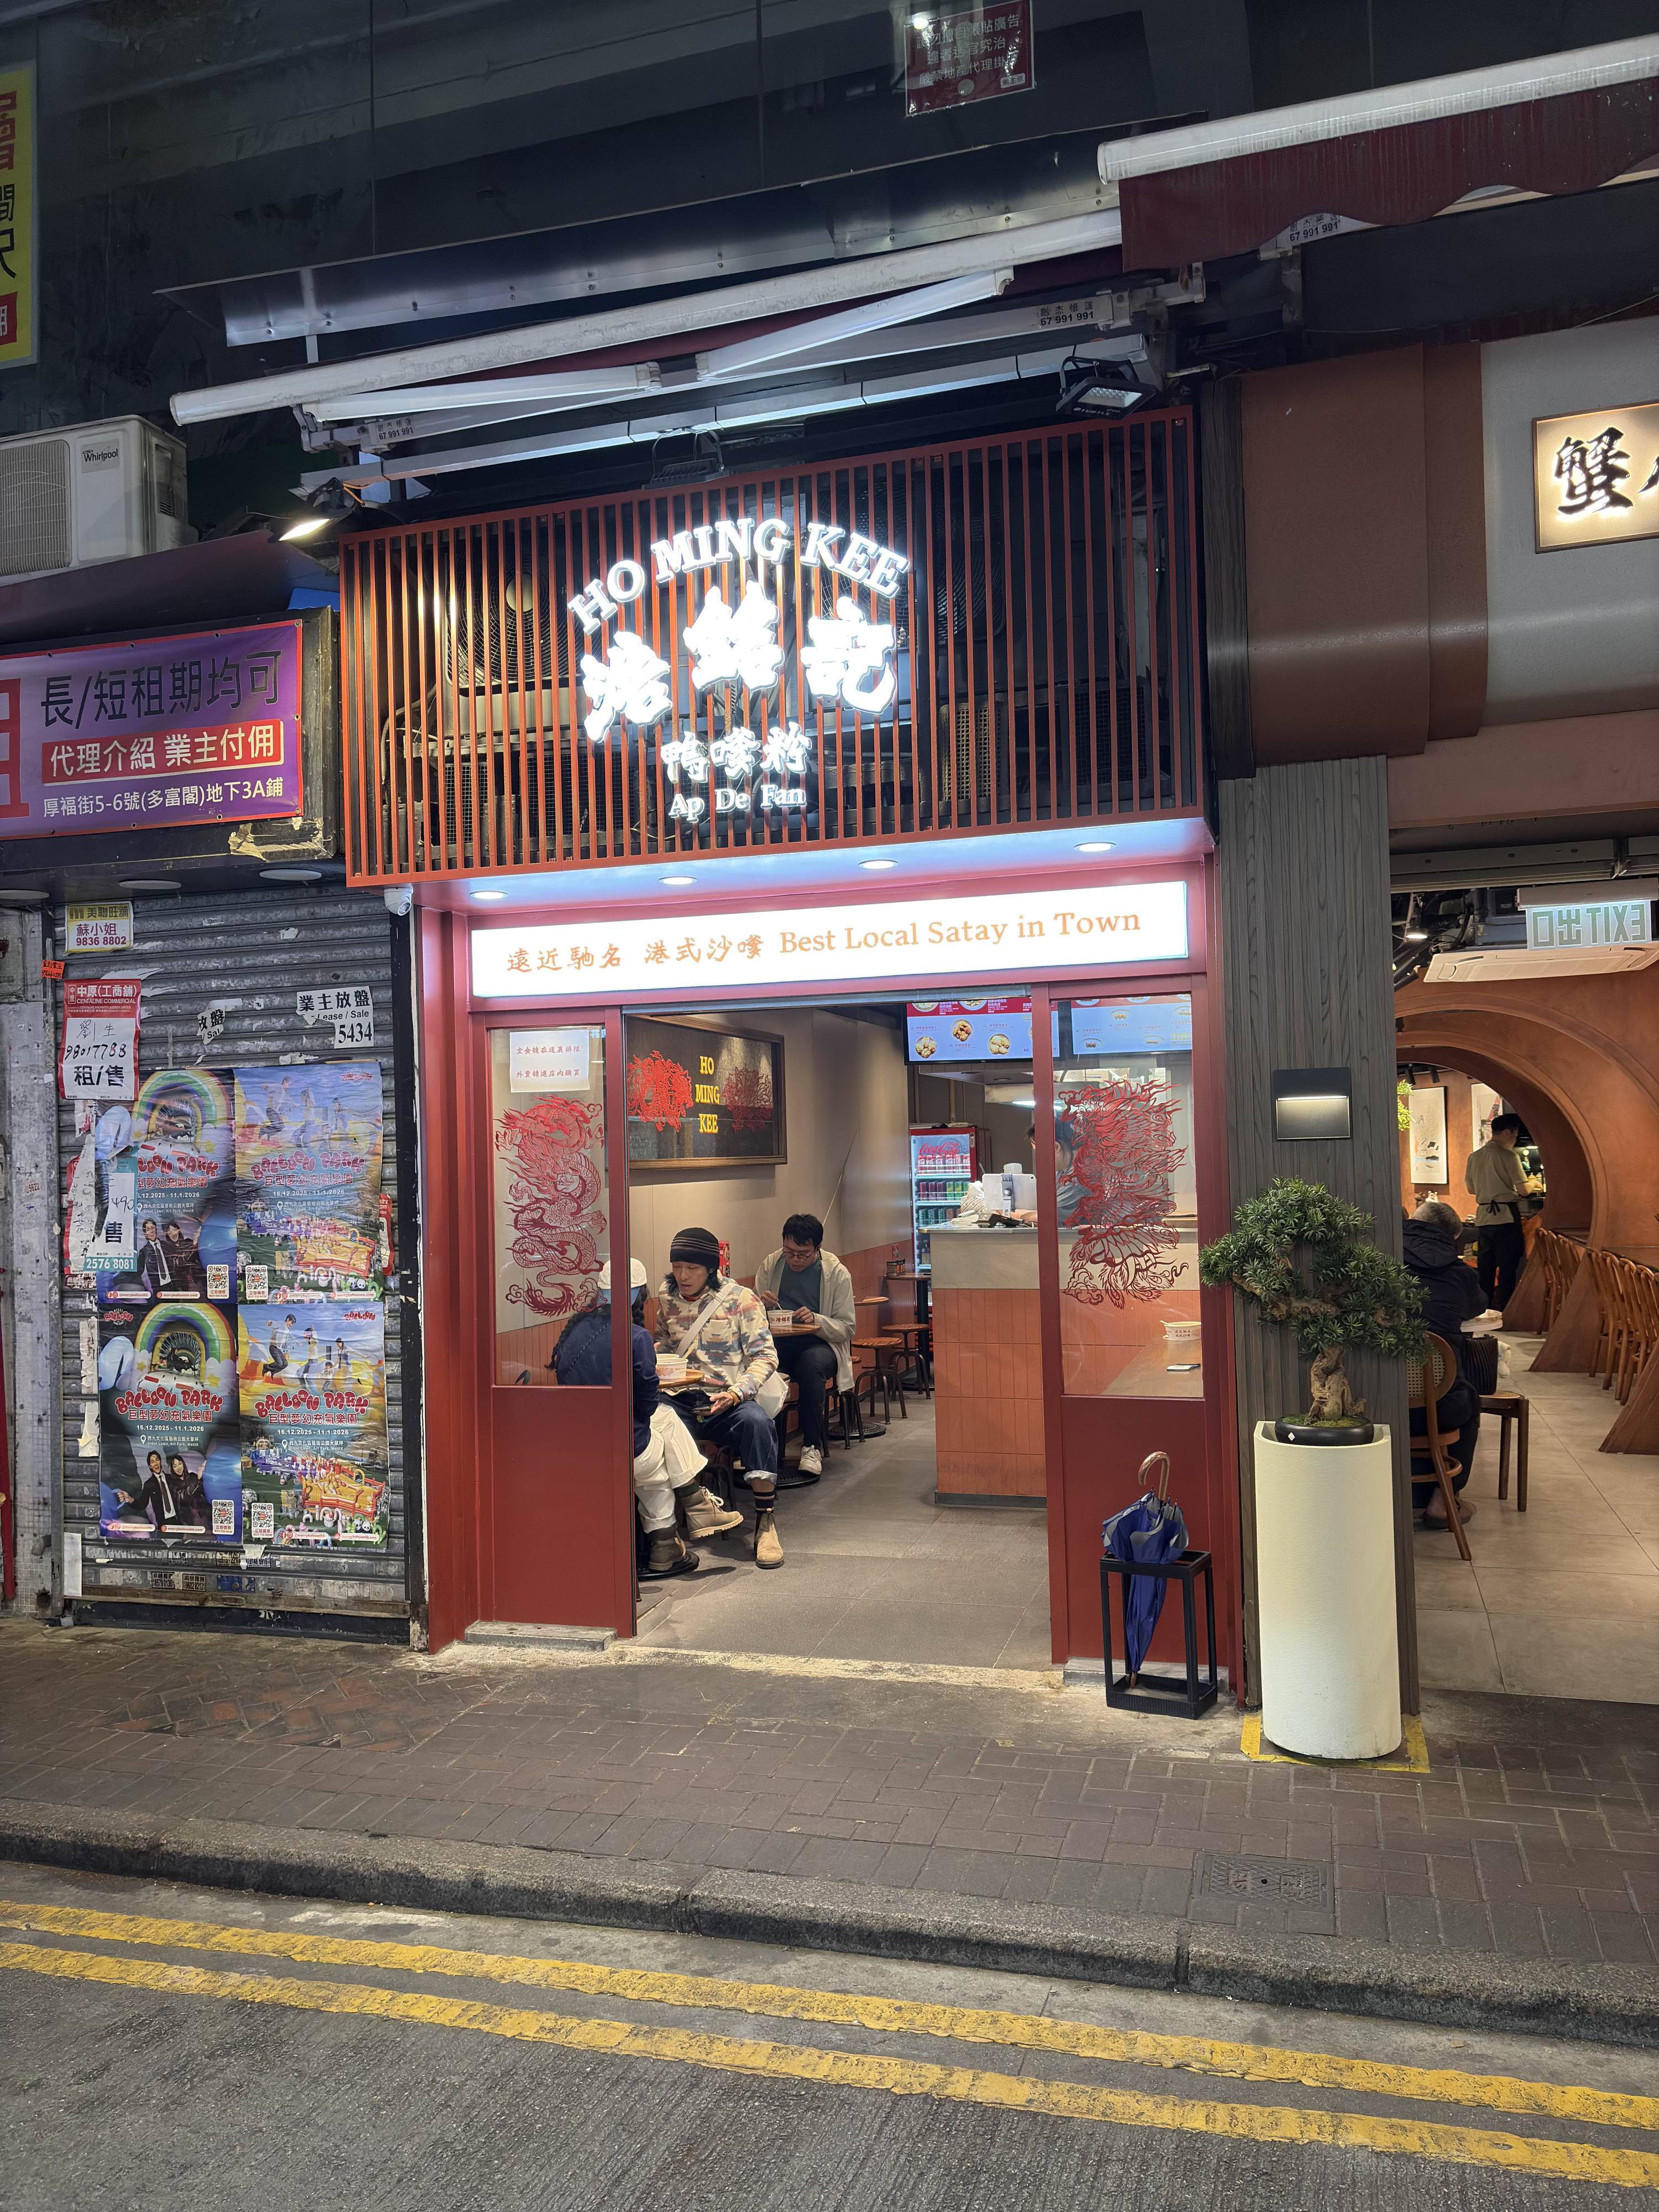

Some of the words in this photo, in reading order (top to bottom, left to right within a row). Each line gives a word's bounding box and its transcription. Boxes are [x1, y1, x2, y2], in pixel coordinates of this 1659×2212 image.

[1290, 232, 1300, 241] 67
[1303, 227, 1318, 238] 991
[1041, 317, 1052, 326] 67
[1055, 314, 1072, 323] 991
[1077, 311, 1093, 320] 991
[388, 429, 400, 437] 991
[401, 426, 413, 435] 991
[83, 448, 118, 462] Whirlpool
[1554, 427, 1659, 515] 蟹
[567, 560, 645, 635] HO
[651, 518, 790, 583] MING
[800, 522, 910, 598] KEE
[41, 650, 281, 729] 長/短租期均可
[51, 735, 155, 776] 代理介紹
[164, 725, 274, 768] 業主付佣
[669, 793, 705, 823] Ap
[714, 788, 750, 813] De
[760, 784, 807, 809] Fan
[76, 923, 117, 936] 蘇小姐
[780, 930, 834, 953] Best
[845, 922, 918, 950] Local
[928, 921, 1008, 945] Satay
[1018, 915, 1045, 938] in
[1053, 912, 1140, 936] Town
[76, 937, 100, 946] 9836
[103, 936, 127, 945] 8802
[507, 942, 620, 973] 遠近馳名
[644, 934, 764, 964] 港式沙嗲
[299, 989, 371, 1012] 業主放盤
[351, 1010, 369, 1019] Sale
[207, 1028, 220, 1039] Sal
[338, 1021, 372, 1044] 5434
[74, 1065, 124, 1087] 租/售
[700, 1056, 714, 1075] HO
[695, 1084, 720, 1105] MING
[699, 1113, 718, 1134] KEE
[176, 1155, 219, 1177] PARK
[251, 1150, 316, 1181] BALLOON
[319, 1151, 366, 1174] PARK
[138, 1176, 208, 1188] 型夢幻充氣樂園
[264, 1172, 353, 1187] 巨型夢幻充氣樂園
[86, 1258, 109, 1269] 2576
[113, 1258, 133, 1269] 8081
[115, 1386, 177, 1414] BALLOON
[181, 1389, 223, 1412] PARK
[254, 1389, 320, 1418] BALLOON
[324, 1391, 369, 1415] PARK
[128, 1409, 212, 1422] 巨型夢幻充氣樂園
[269, 1413, 358, 1425] 巨型夢幻充氣樂園
